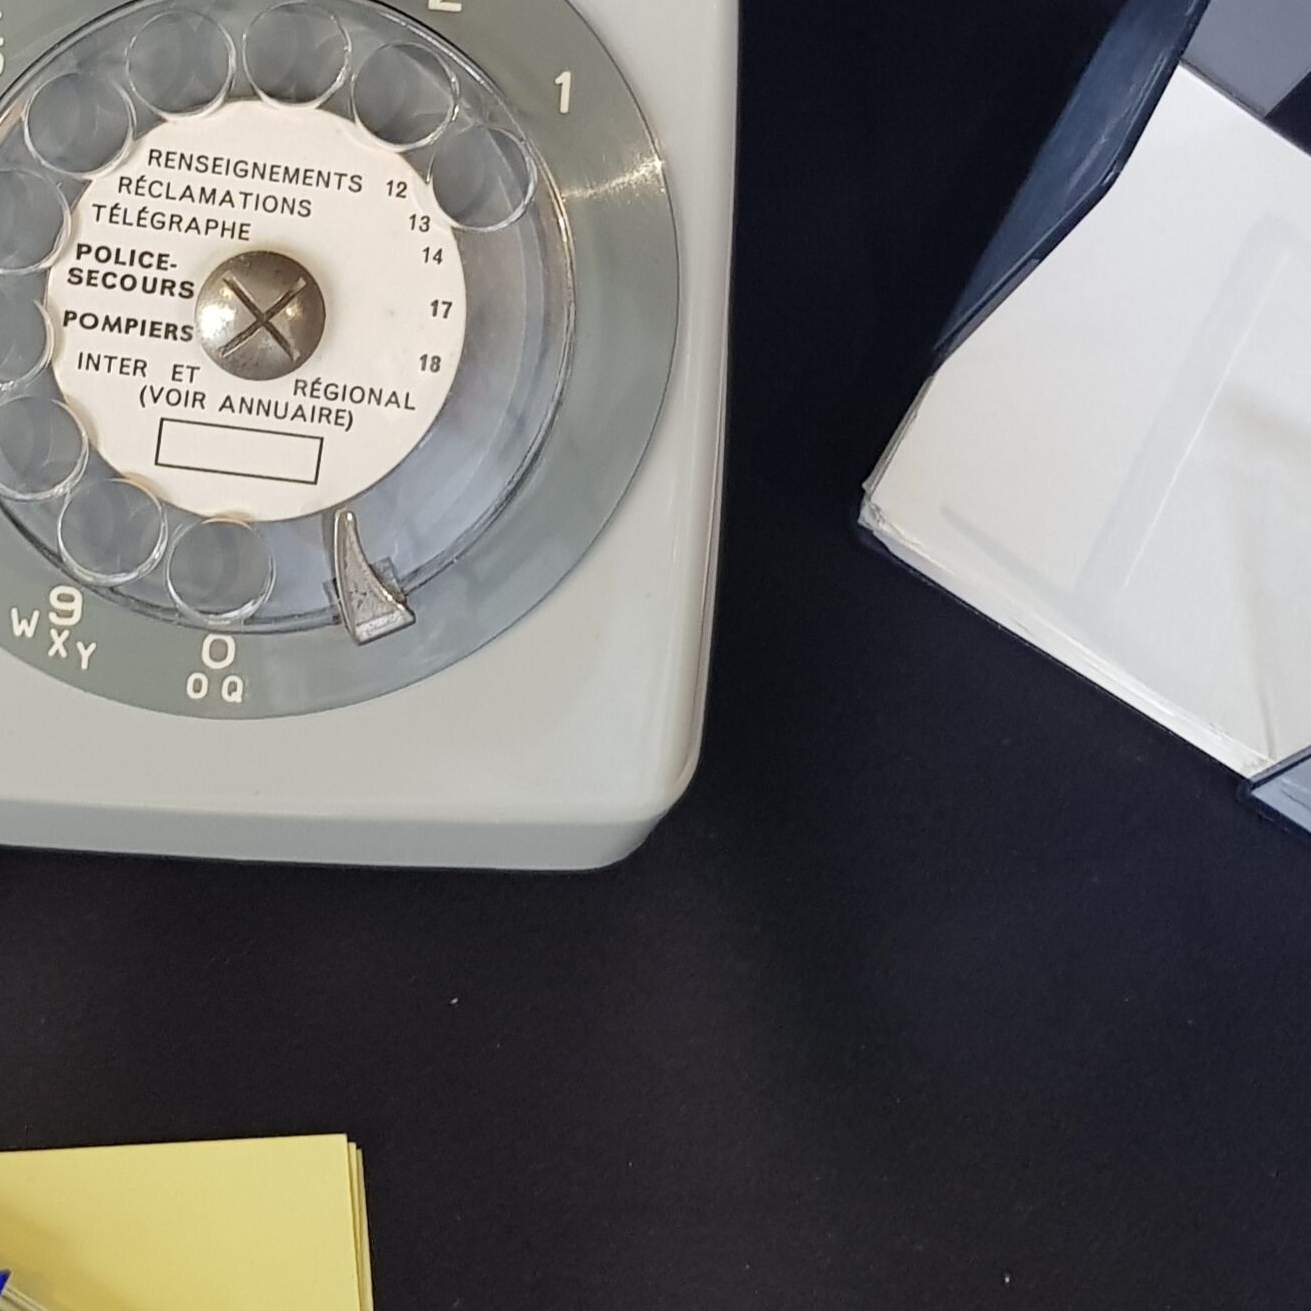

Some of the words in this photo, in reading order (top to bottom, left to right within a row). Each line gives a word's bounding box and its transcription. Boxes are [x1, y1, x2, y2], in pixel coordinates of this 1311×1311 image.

[553, 70, 572, 114] 1
[148, 148, 364, 193] RENSEIGNEMENTS
[385, 179, 408, 199] 12
[117, 175, 313, 218] RÉCLAMATIONS
[408, 213, 431, 233] 13
[75, 243, 178, 271] POLICE-
[92, 203, 252, 241] TÉLÉGRAPHE
[421, 246, 444, 265] 14
[66, 267, 195, 299] SECOURS
[429, 300, 452, 319] 17
[62, 310, 194, 342] POMPIERS
[419, 354, 441, 373] 18
[77, 352, 148, 378] INTER
[171, 363, 201, 383] ET
[293, 378, 416, 411] RÉGIONAL
[139, 384, 207, 409] (VOIR
[218, 394, 354, 431] ANNUAIRE)
[48, 585, 83, 627] 9
[10, 607, 97, 671] WXY
